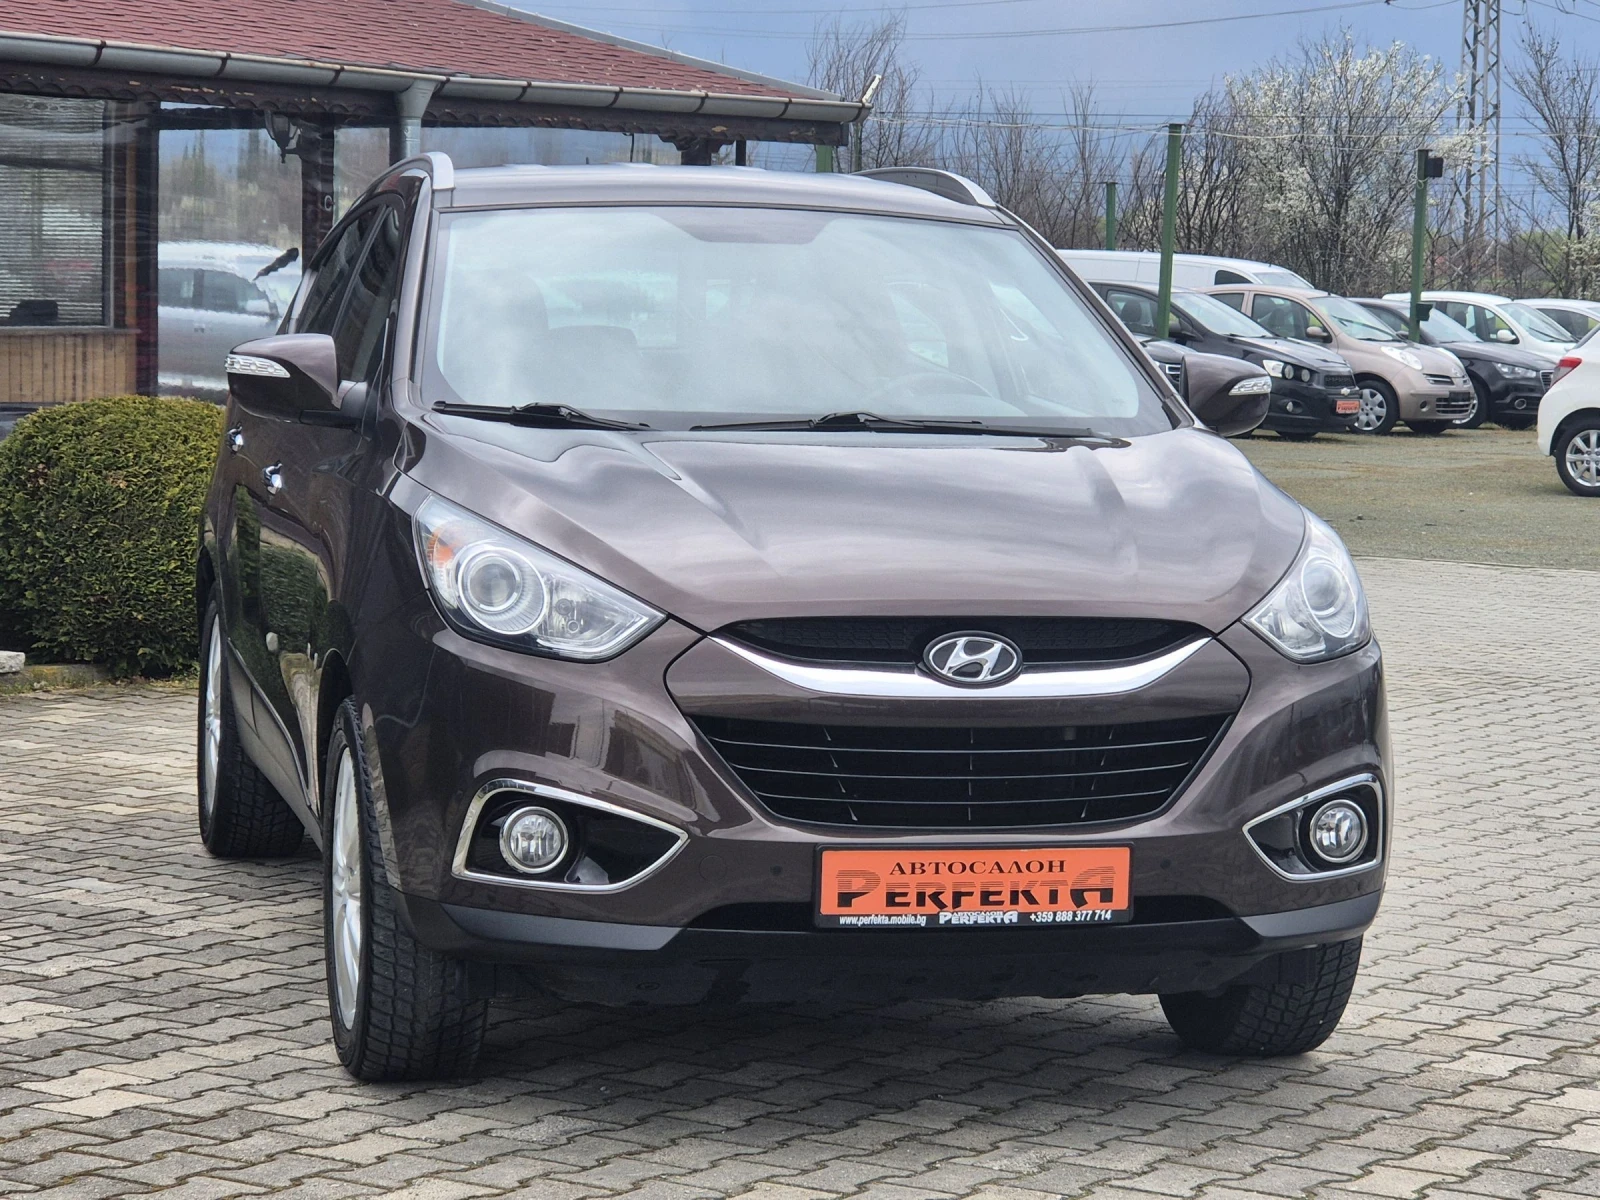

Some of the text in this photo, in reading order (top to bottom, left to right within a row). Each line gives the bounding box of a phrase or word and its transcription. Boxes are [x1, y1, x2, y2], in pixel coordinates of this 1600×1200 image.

[889, 859, 1067, 875] АВТОСАЛОН
[836, 865, 1116, 910] PERFEKTA
[839, 914, 927, 927] www.perfekta.mobile.bg
[938, 910, 1019, 925] PERFEKTA
[1029, 909, 1112, 923] +359 888 377 714
